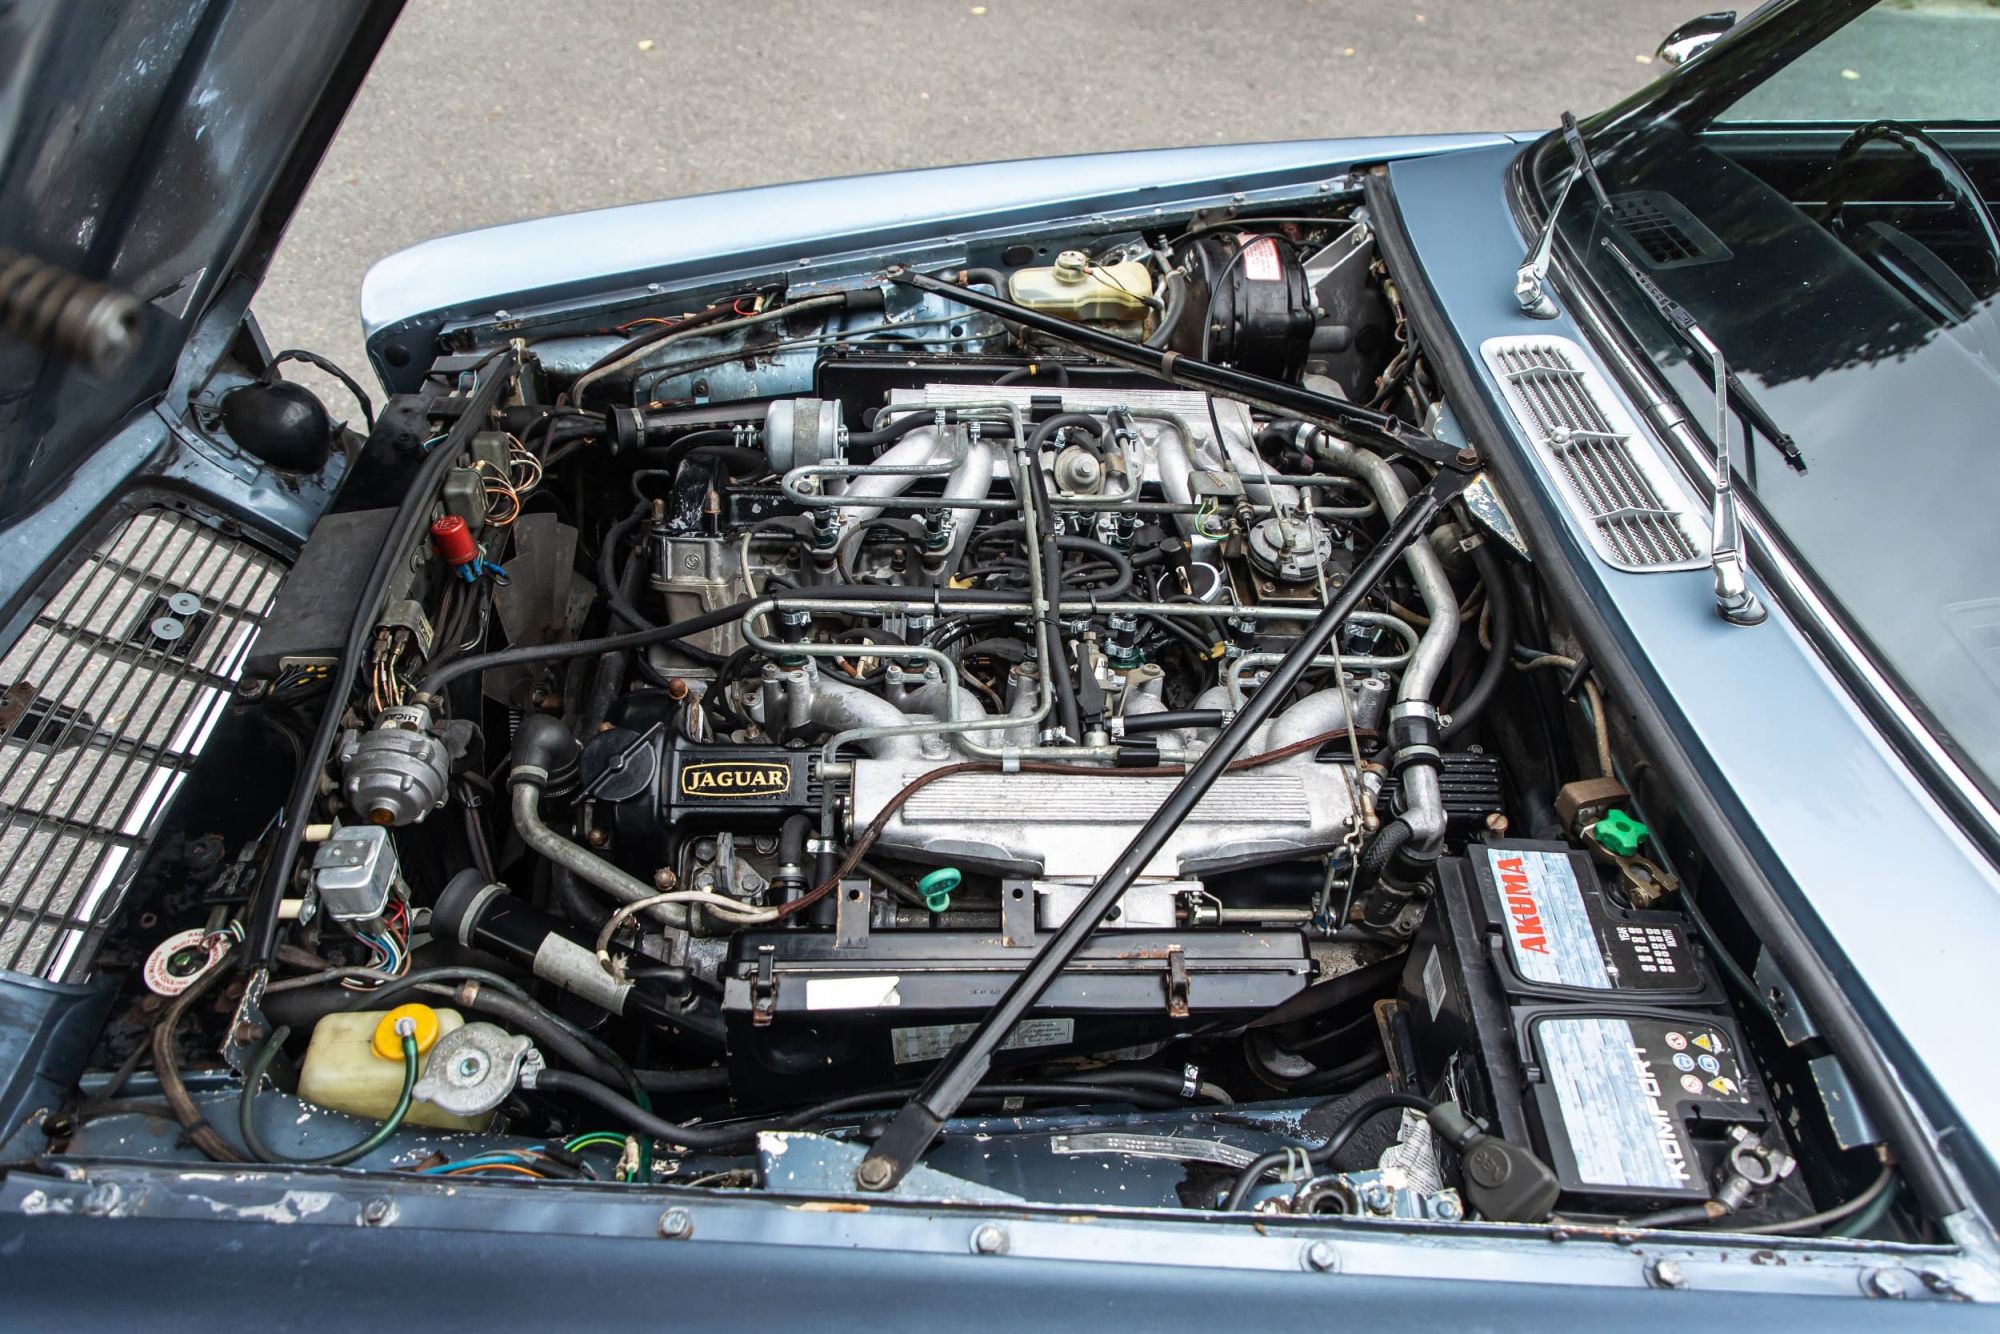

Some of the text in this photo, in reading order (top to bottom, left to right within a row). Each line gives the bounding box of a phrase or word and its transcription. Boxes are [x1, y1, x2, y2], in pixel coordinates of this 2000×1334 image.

[688, 771, 785, 790] JAGUAR
[1497, 857, 1549, 955] AKUMA
[1626, 1043, 1690, 1180] KOMFORT
